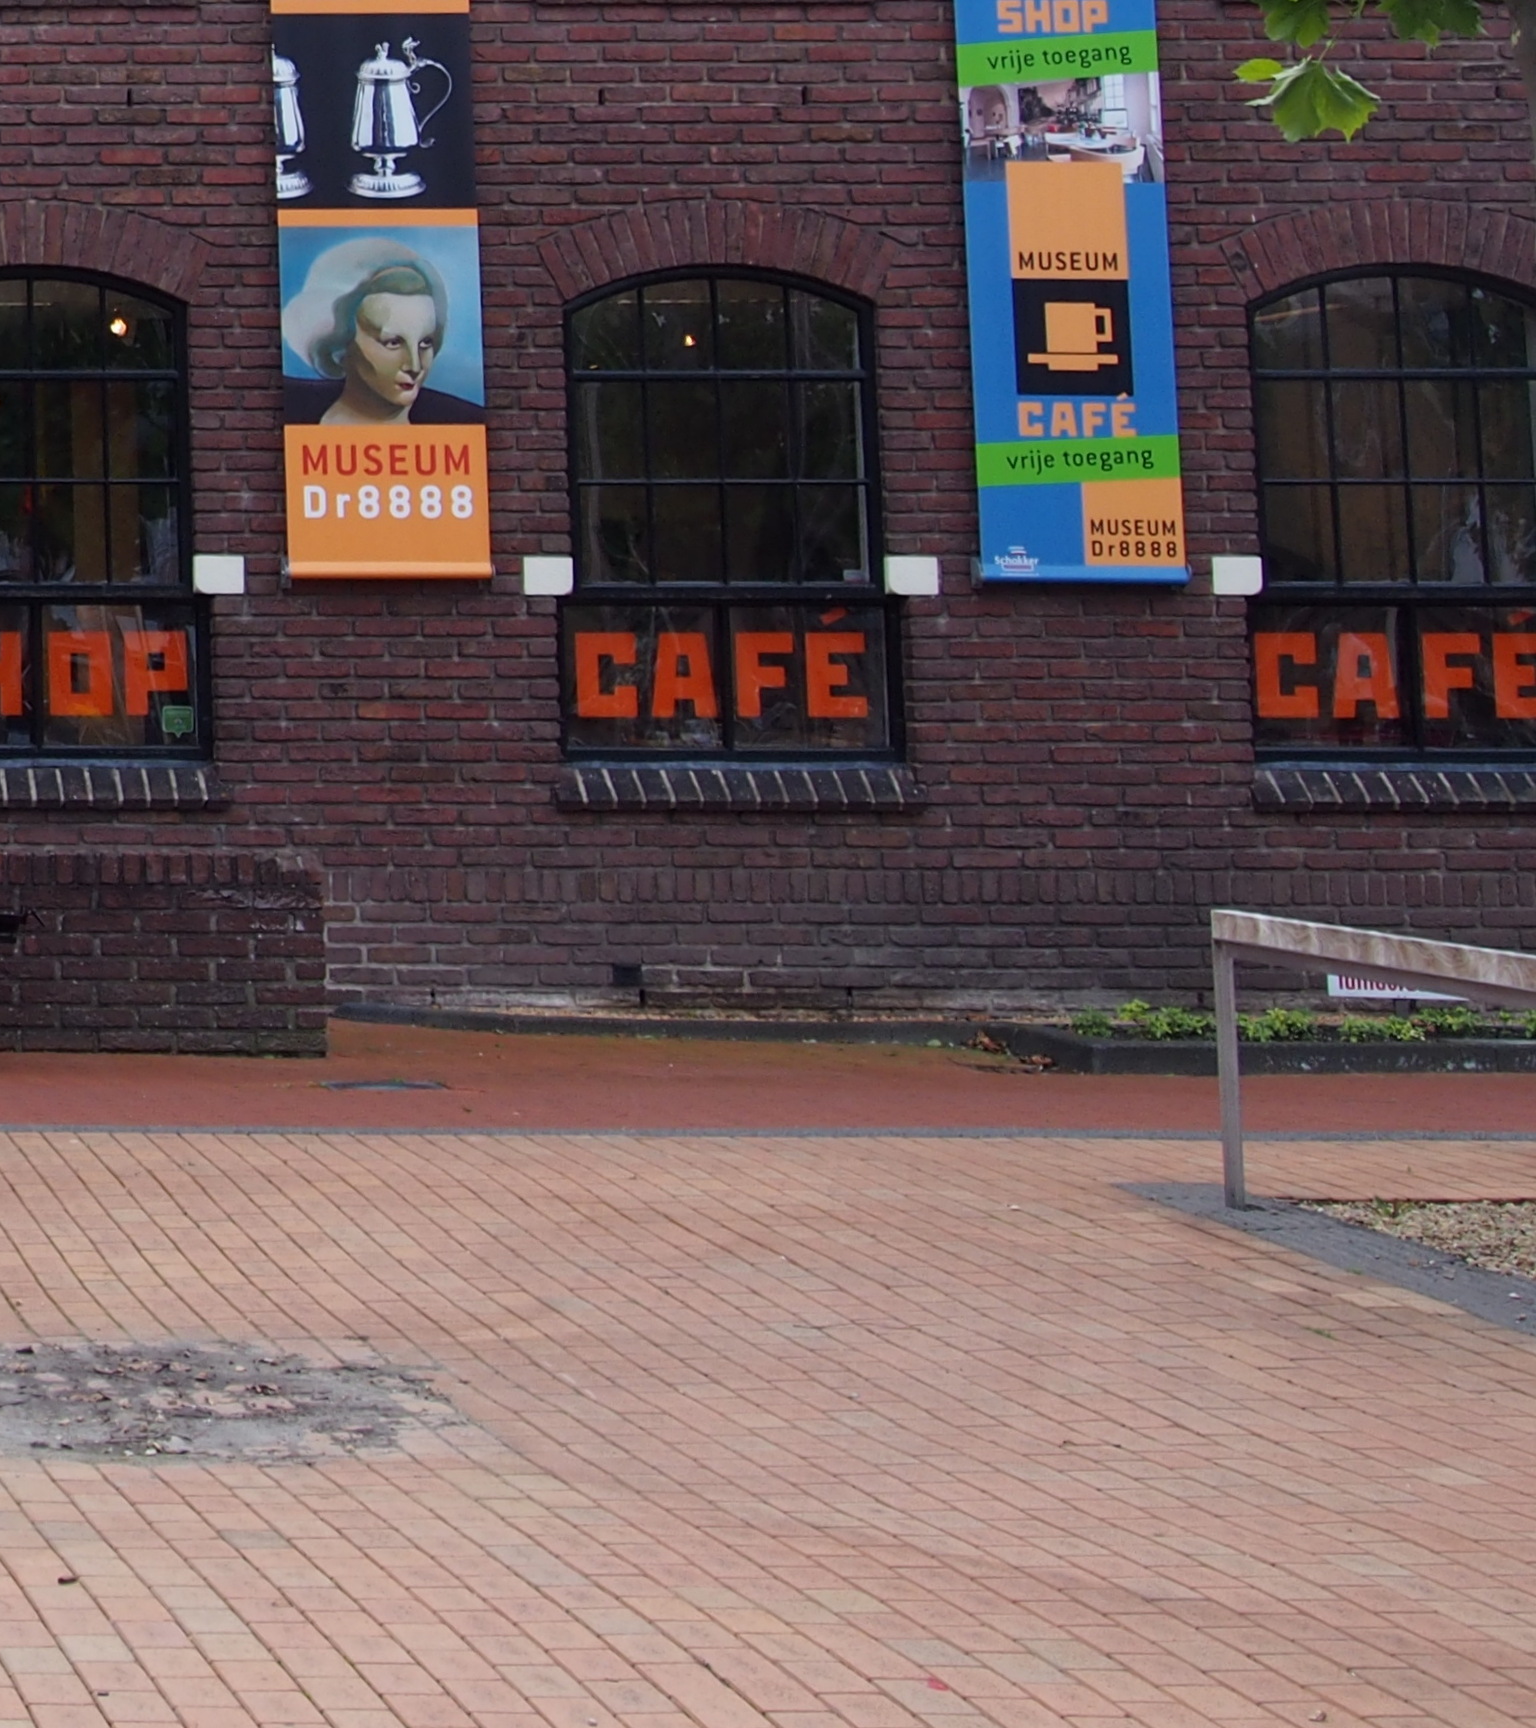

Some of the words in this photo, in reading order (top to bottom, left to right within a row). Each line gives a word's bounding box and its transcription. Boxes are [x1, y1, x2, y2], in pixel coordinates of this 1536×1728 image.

[987, 49, 1035, 74] vrije
[1042, 45, 1133, 69] toegang
[1018, 251, 1119, 271] MUSEUM
[1017, 392, 1138, 438] CAFÉ
[301, 444, 471, 476] MUSEUM
[1007, 450, 1055, 475] vrije
[1063, 449, 1155, 472] toegang
[303, 484, 474, 519] Dr8888
[1090, 519, 1177, 537] MUSEUM
[1091, 539, 1178, 558] Dr8888
[574, 607, 869, 718] CAFÉ
[1254, 610, 1536, 719] CAFÉ
